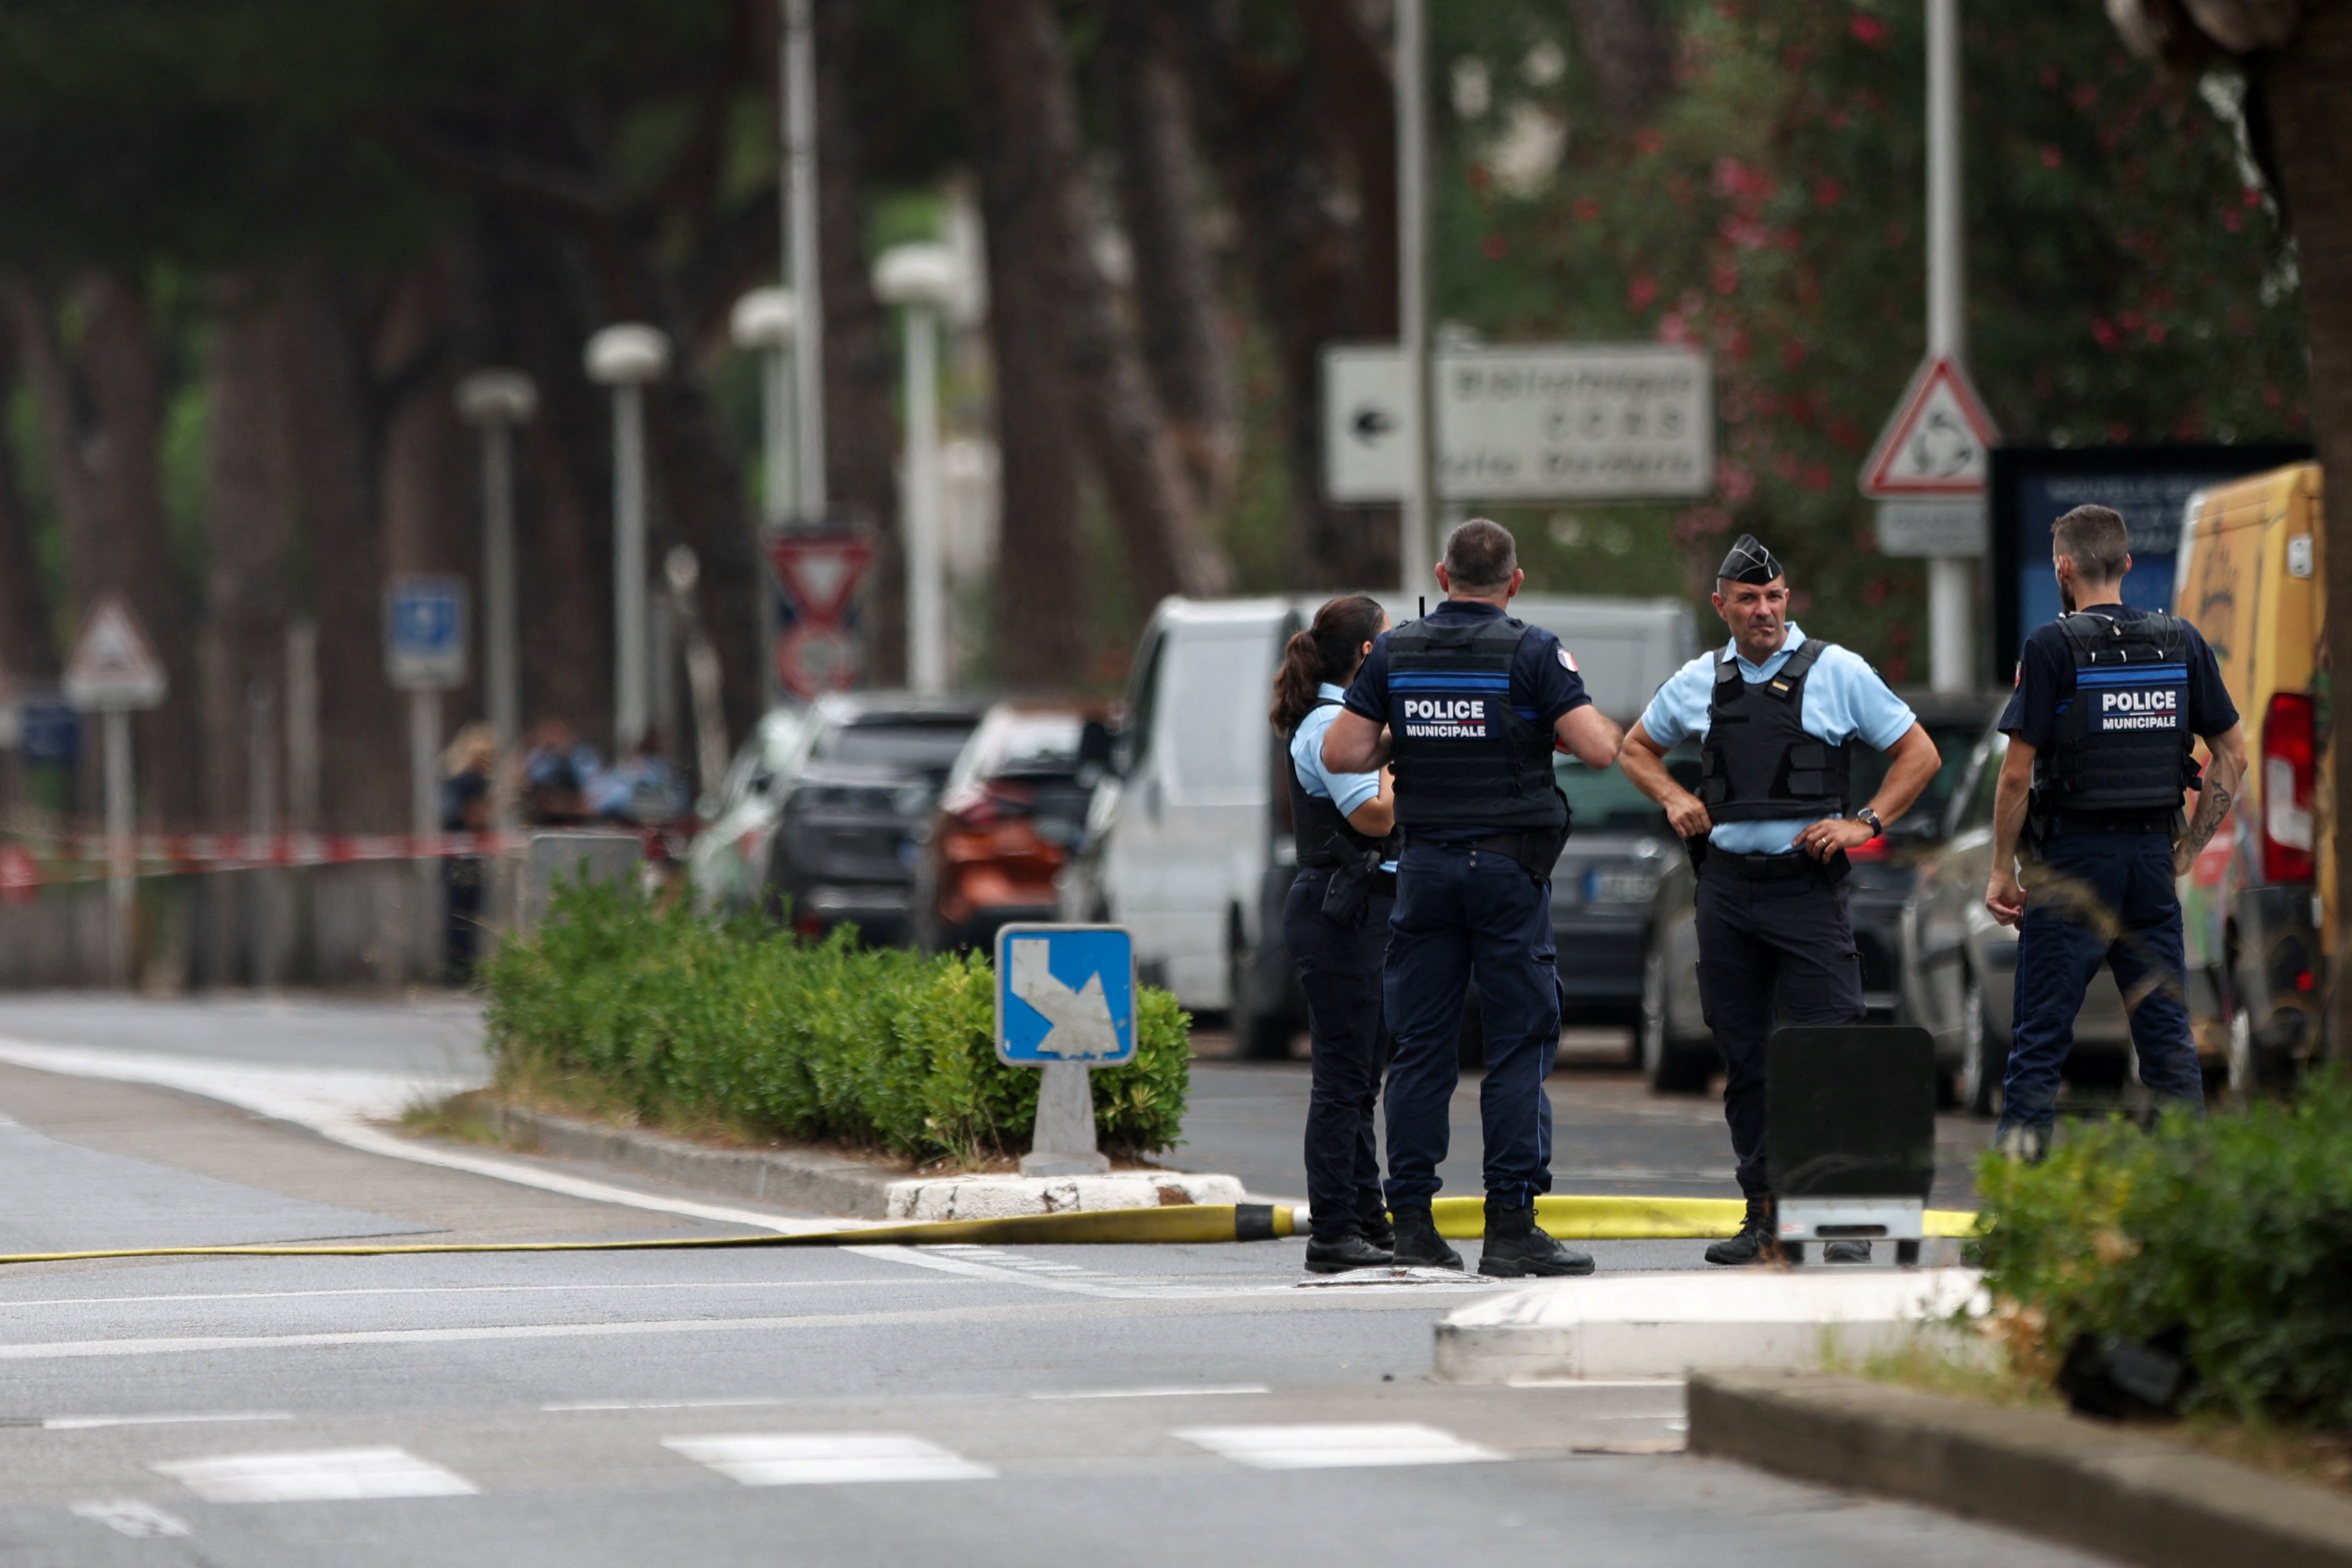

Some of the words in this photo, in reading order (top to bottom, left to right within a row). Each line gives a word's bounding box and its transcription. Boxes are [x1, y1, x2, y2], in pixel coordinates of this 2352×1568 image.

[1404, 700, 1485, 719] POLICE
[2102, 691, 2176, 712] POLICE
[1406, 725, 1486, 737] MUNICIPALE
[2103, 716, 2176, 730] MUNICIPALE
